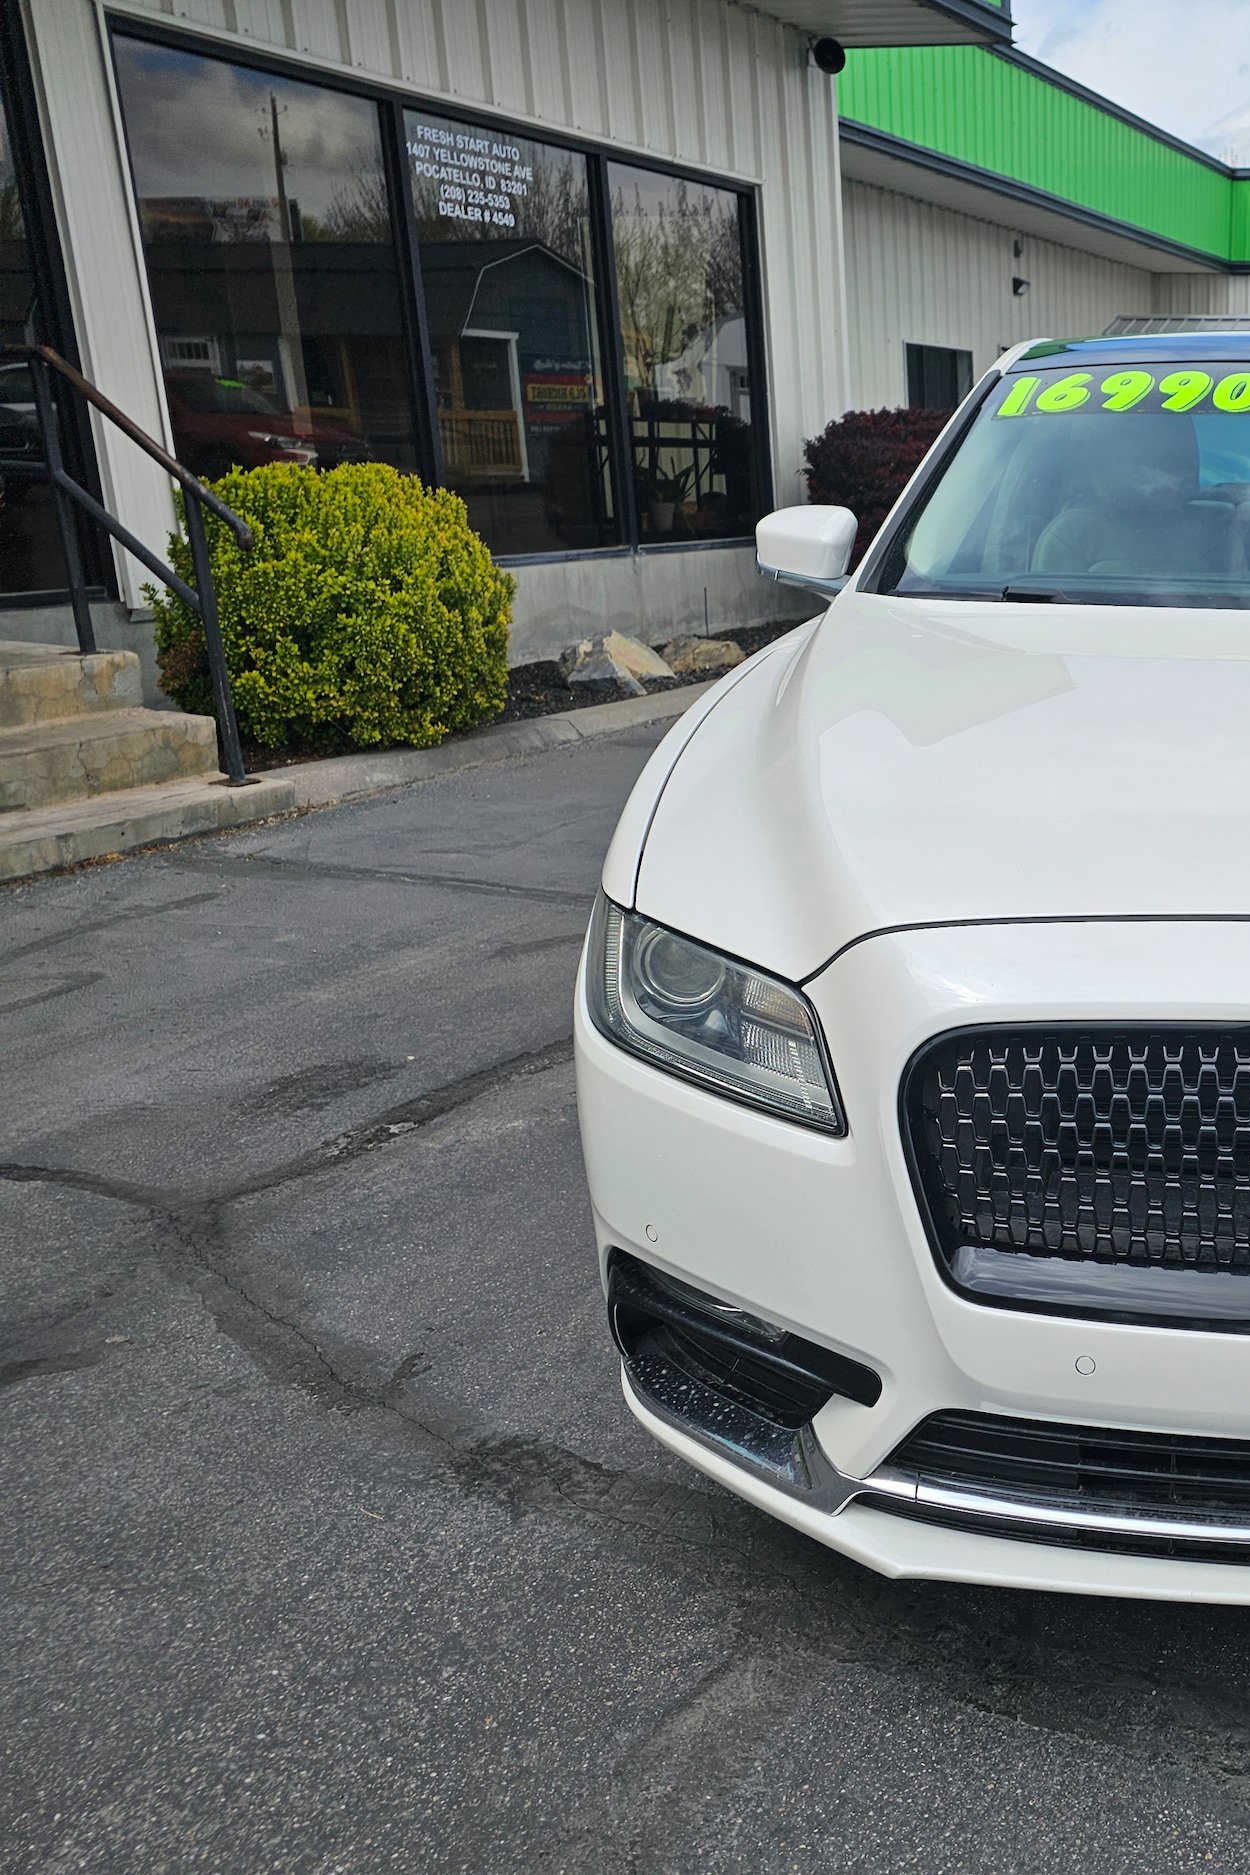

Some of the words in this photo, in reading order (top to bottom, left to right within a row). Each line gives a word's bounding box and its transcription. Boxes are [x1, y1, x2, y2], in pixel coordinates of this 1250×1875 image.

[416, 125, 454, 146] FRESH
[456, 134, 490, 155] START
[492, 143, 520, 161] AUTO
[406, 141, 430, 159] 1407
[433, 147, 512, 177] YELLOWSTONE
[513, 166, 533, 181] AVE
[415, 161, 484, 189] POCATELLO,
[485, 175, 496, 190] ID
[500, 179, 528, 196] 83201
[440, 184, 466, 204] (208)
[467, 189, 511, 210] 235-5353
[439, 202, 483, 222] DEALER
[483, 210, 491, 223] #
[492, 211, 515, 228] 4549
